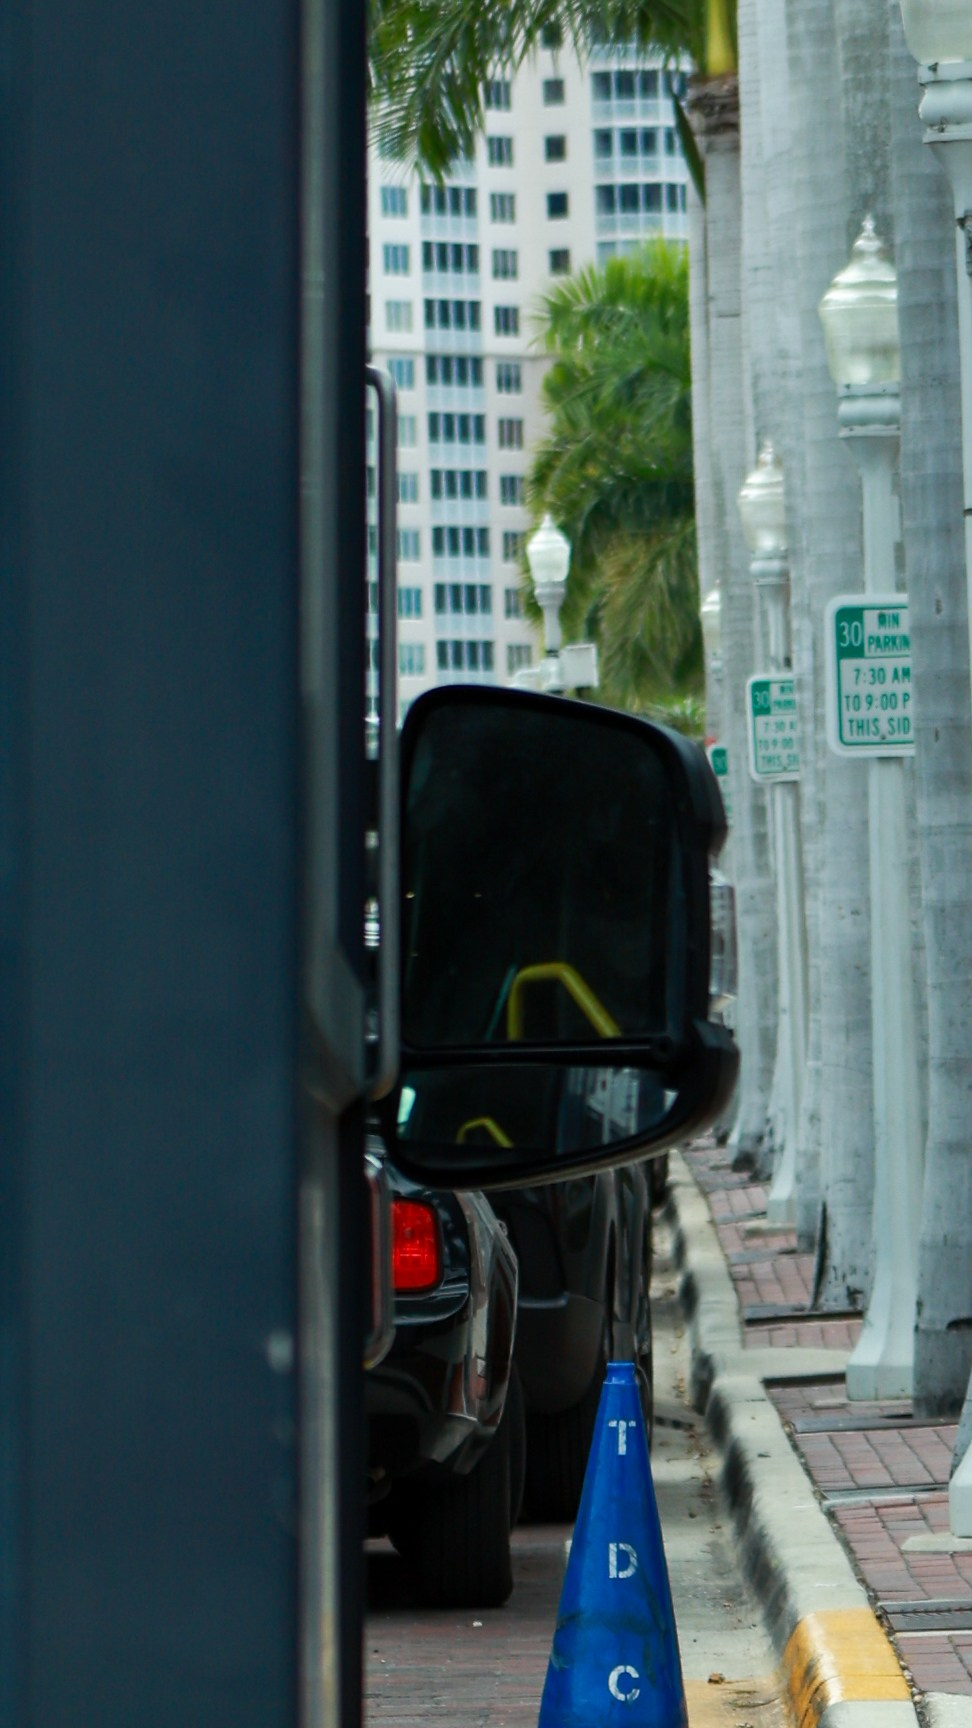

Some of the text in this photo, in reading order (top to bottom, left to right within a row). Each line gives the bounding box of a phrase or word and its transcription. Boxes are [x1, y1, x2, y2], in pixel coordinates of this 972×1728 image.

[877, 612, 899, 629] MIN
[839, 622, 862, 647] 30
[854, 668, 886, 685] 7:30
[754, 691, 769, 708] 30
[845, 695, 861, 712] TO
[866, 693, 897, 711] 9:00
[849, 717, 910, 736] THIS SID
